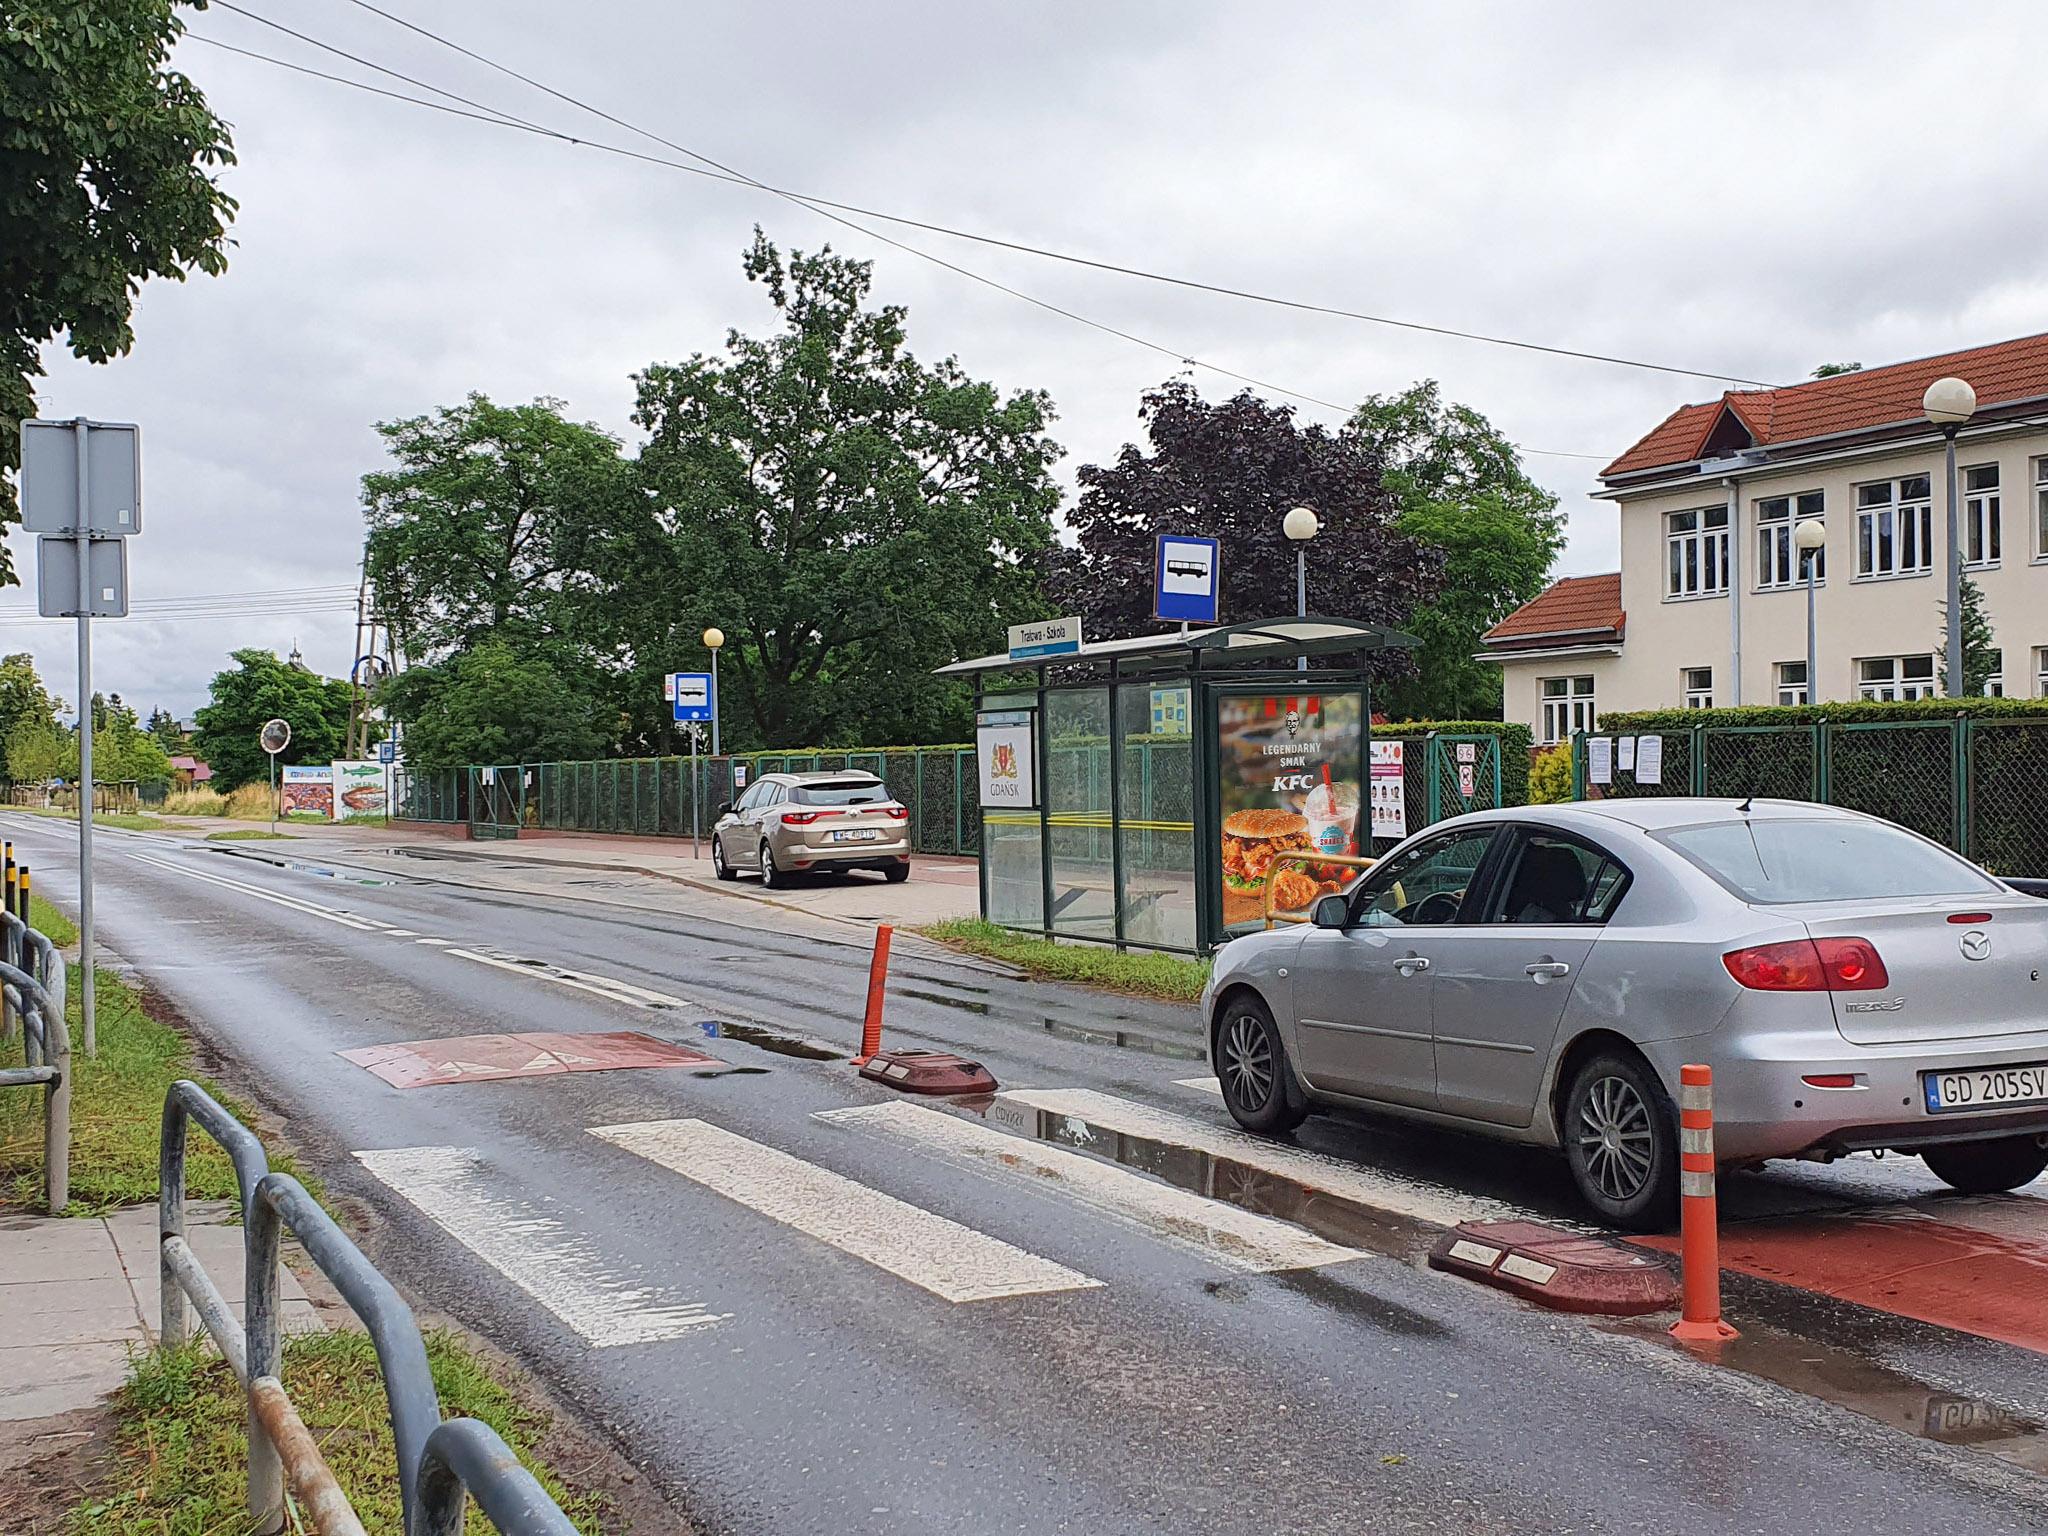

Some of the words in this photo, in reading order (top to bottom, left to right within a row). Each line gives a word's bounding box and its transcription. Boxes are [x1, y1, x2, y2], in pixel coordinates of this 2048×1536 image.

[1262, 742, 1321, 755] LEGENDARNY
[1280, 755, 1306, 767] SMAK
[990, 780, 1020, 797] GDAŃSK
[1271, 774, 1314, 792] KFC
[1943, 1075, 1973, 1103] GD
[1980, 1069, 2045, 1101] 205SV
